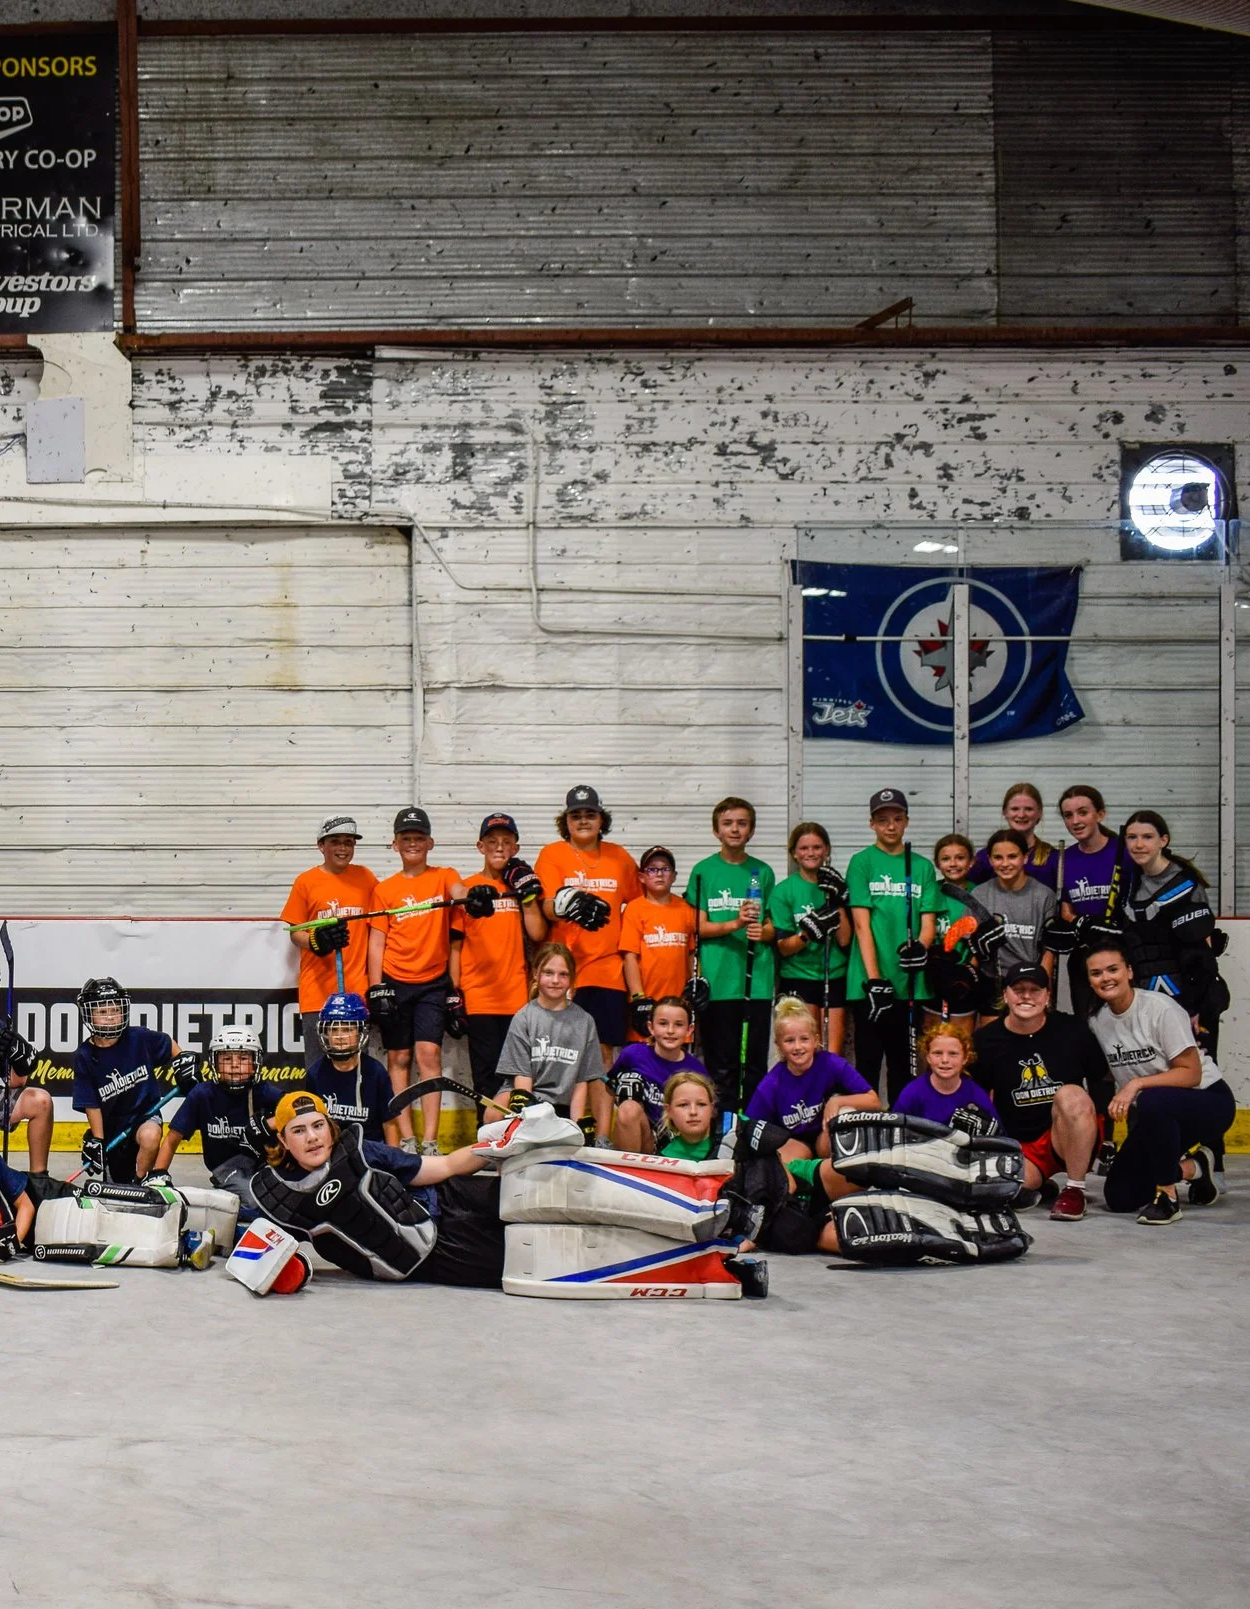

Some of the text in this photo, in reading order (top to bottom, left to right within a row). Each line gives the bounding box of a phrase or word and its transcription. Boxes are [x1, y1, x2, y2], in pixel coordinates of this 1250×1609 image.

[24, 149, 97, 169] CO-OP
[812, 701, 871, 728] Jets
[1172, 908, 1210, 929] BAUER
[18, 1002, 93, 1053] DO
[99, 1081, 116, 1098] DON
[802, 1102, 823, 1118] DIET
[621, 1152, 680, 1166] CCM
[102, 1187, 145, 1198] WARRIOR
[630, 1287, 687, 1297] CCM
